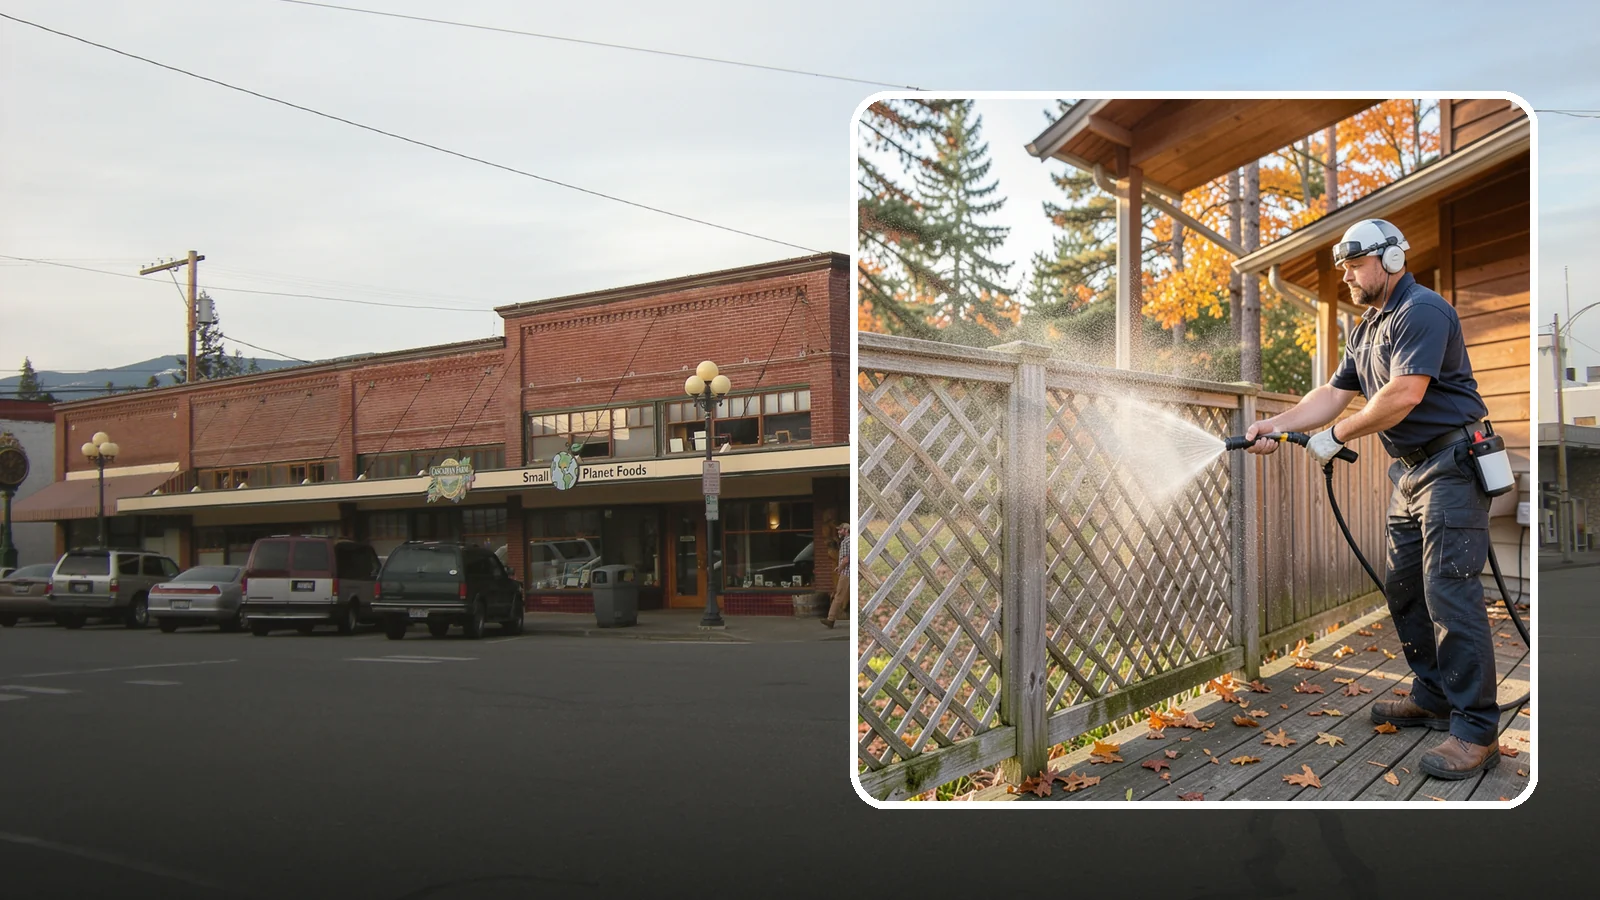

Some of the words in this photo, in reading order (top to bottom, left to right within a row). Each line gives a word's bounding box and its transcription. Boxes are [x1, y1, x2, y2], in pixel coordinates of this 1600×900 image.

[523, 471, 549, 483] Small
[583, 468, 614, 479] Planet
[617, 465, 647, 477] Foods
